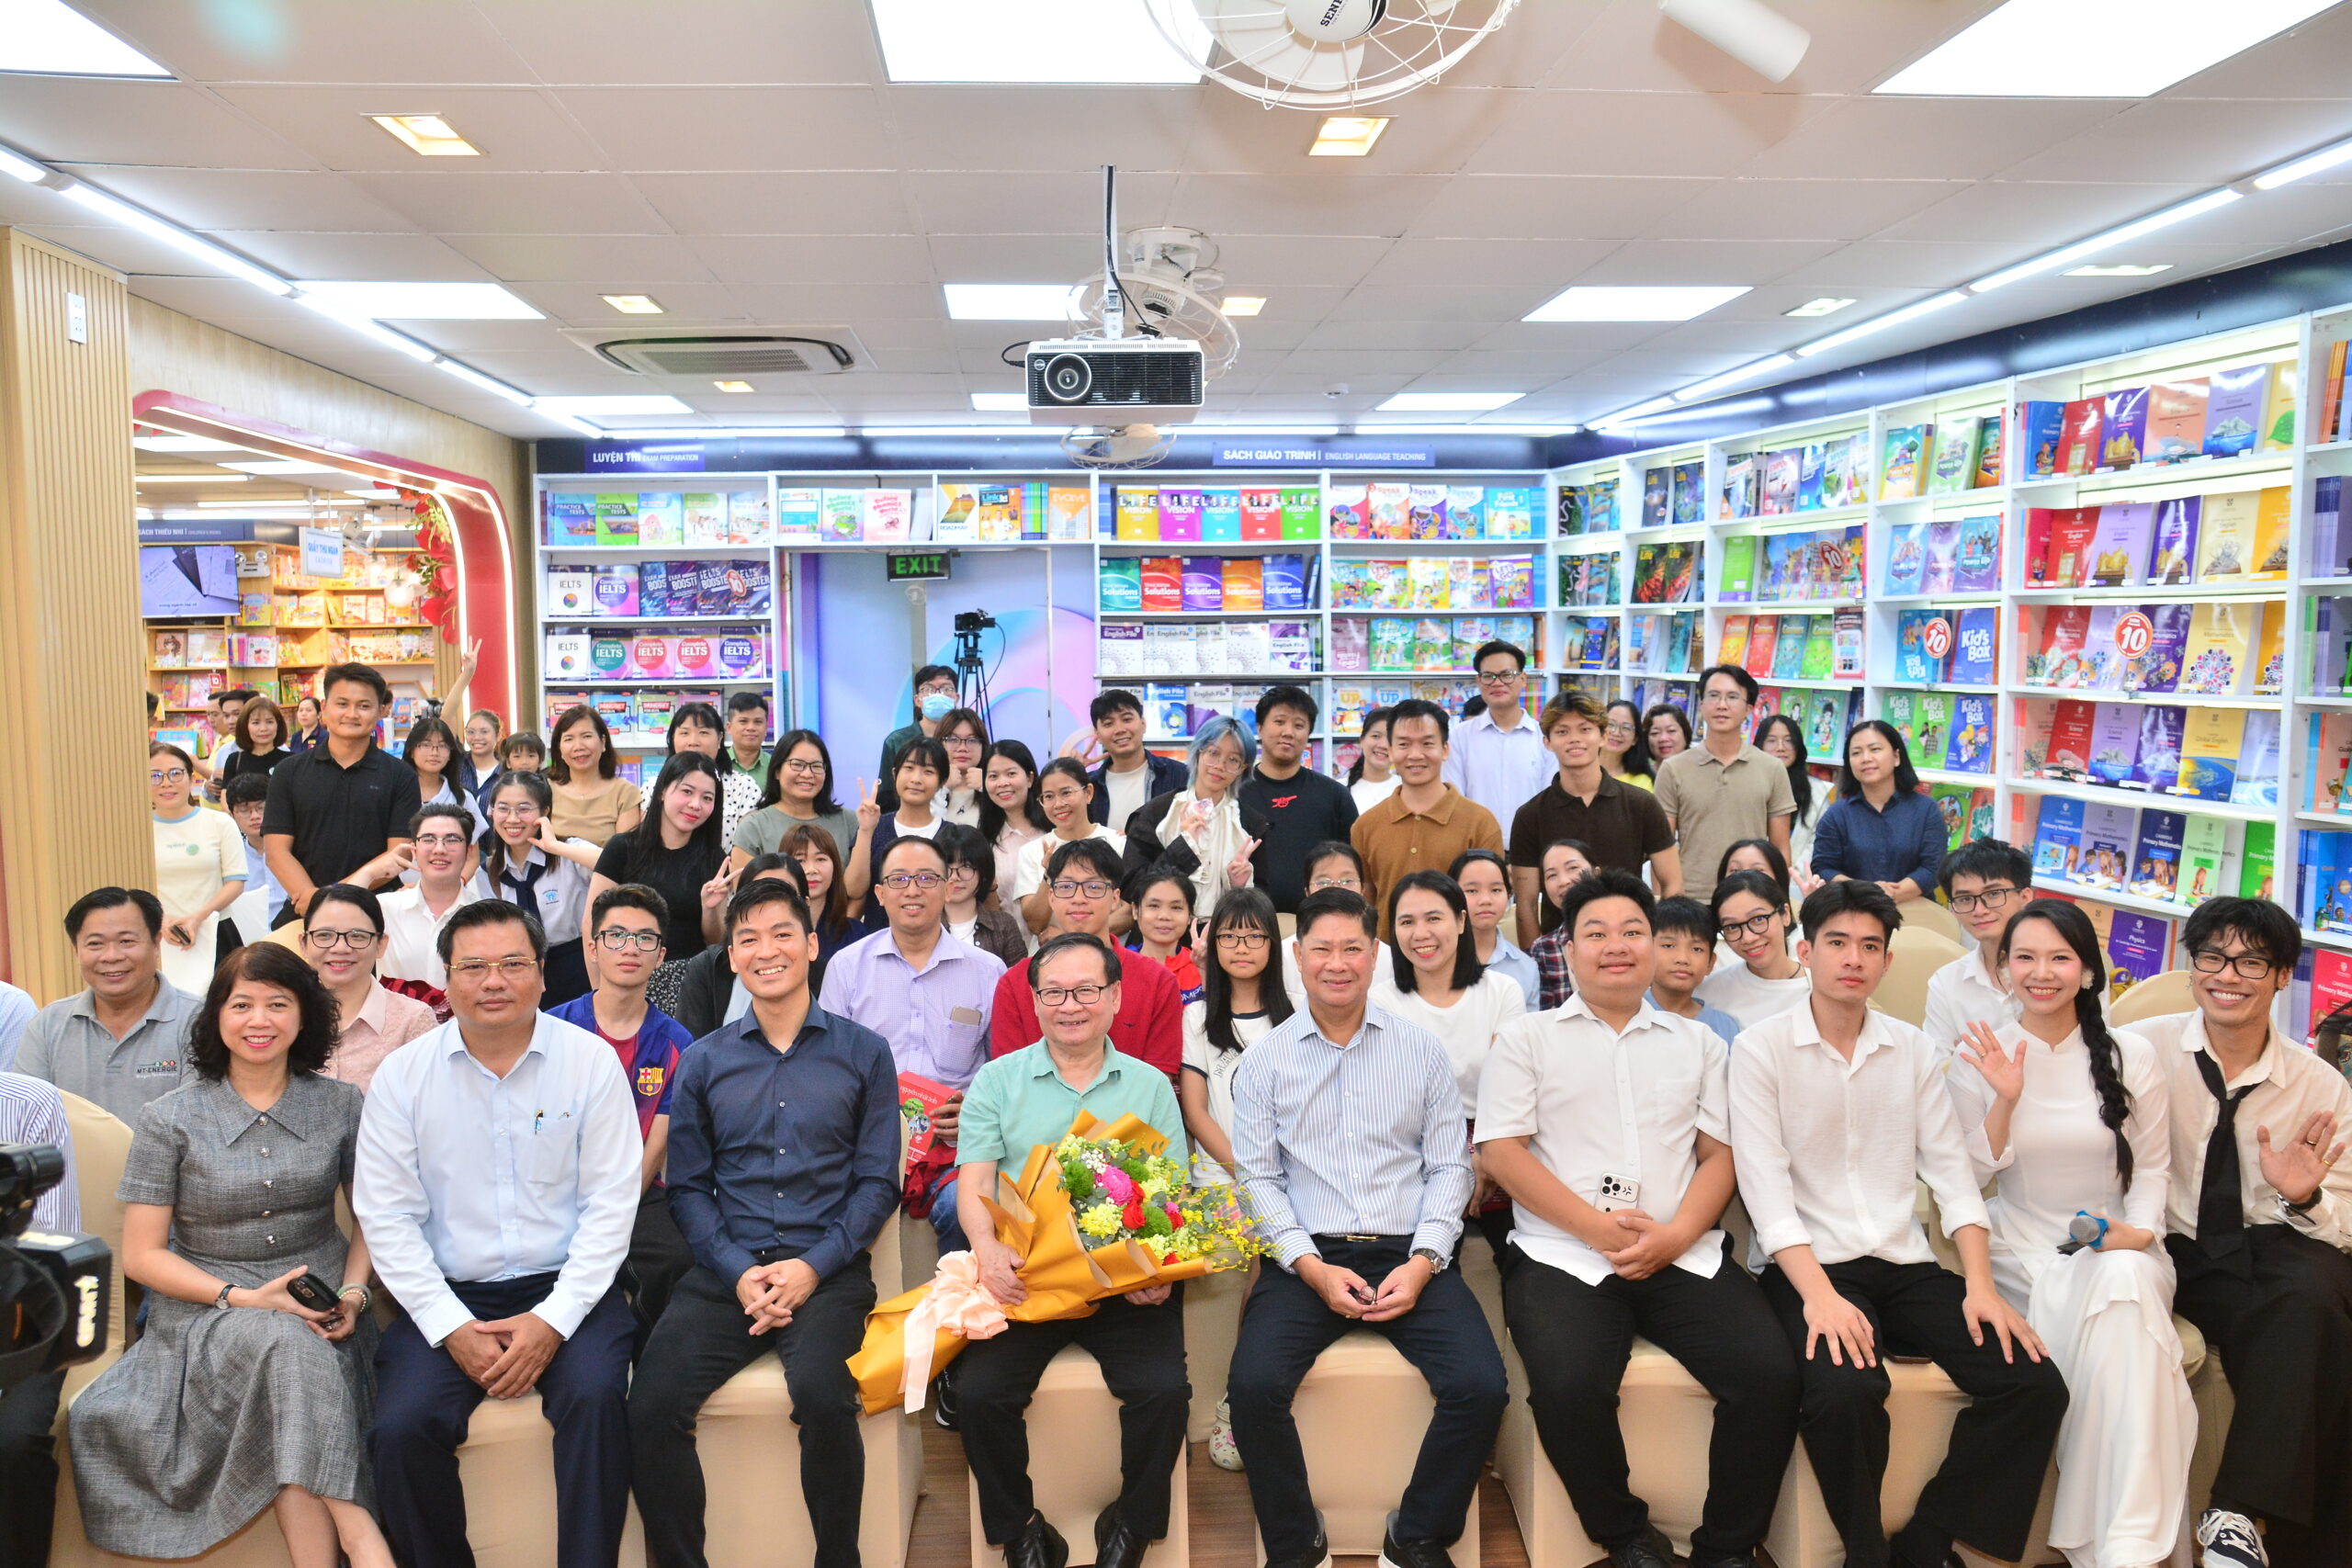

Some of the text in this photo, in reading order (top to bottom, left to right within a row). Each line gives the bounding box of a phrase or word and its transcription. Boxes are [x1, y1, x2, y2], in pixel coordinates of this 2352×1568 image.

[593, 451, 624, 464] LUYỆN
[626, 452, 641, 462] THI
[1224, 448, 1427, 462] SÁCH GIÁO TRÌNH ENGLISH LANGUAGE TEACHING
[1052, 493, 1087, 502] EVOLVE
[1119, 494, 1158, 506] LIFE
[1162, 494, 1200, 506] LIFE
[1202, 495, 1238, 506] LIFE
[1280, 493, 1318, 505] LIFE
[1124, 506, 1152, 514] VISION
[1167, 505, 1195, 513] VISION
[1205, 506, 1234, 514] VISION
[1247, 505, 1275, 513] VISION
[1285, 504, 1314, 513] VISION
[896, 555, 942, 574] EXIT
[1825, 551, 1841, 569] 10
[1495, 564, 1515, 574] LET'S
[1500, 571, 1513, 580] GO
[560, 581, 582, 589] IELTS
[599, 584, 626, 593] IELTS
[1102, 588, 1138, 596] Solutions
[1145, 587, 1181, 595] Solutions
[1185, 587, 1220, 595] Solutions
[1225, 587, 1261, 595] Solutions
[1266, 586, 1302, 594] Solutions
[1927, 629, 1947, 653] 10
[1961, 628, 1990, 648] Kid's
[2121, 626, 2147, 651] 10
[596, 649, 623, 658] IELTS
[638, 648, 664, 656] IELTS
[681, 647, 707, 656] IELTS
[724, 647, 751, 656] IELTS
[1193, 690, 1216, 698] English
[1340, 692, 1360, 704] UP
[1381, 693, 1400, 704] UP
[1890, 695, 1909, 708] Kid's
[1923, 696, 1944, 710] Kid's
[1962, 699, 1983, 713] Kid's
[2042, 822, 2058, 831] Primary
[2086, 829, 2102, 839] Primary
[2102, 832, 2128, 841] Mathematics
[2143, 838, 2158, 847] Primary
[2249, 852, 2268, 862] Primary
[2128, 934, 2146, 944] Physics
[2317, 984, 2336, 996] Primary
[137, 1066, 177, 1074] MT-ENERGIE
